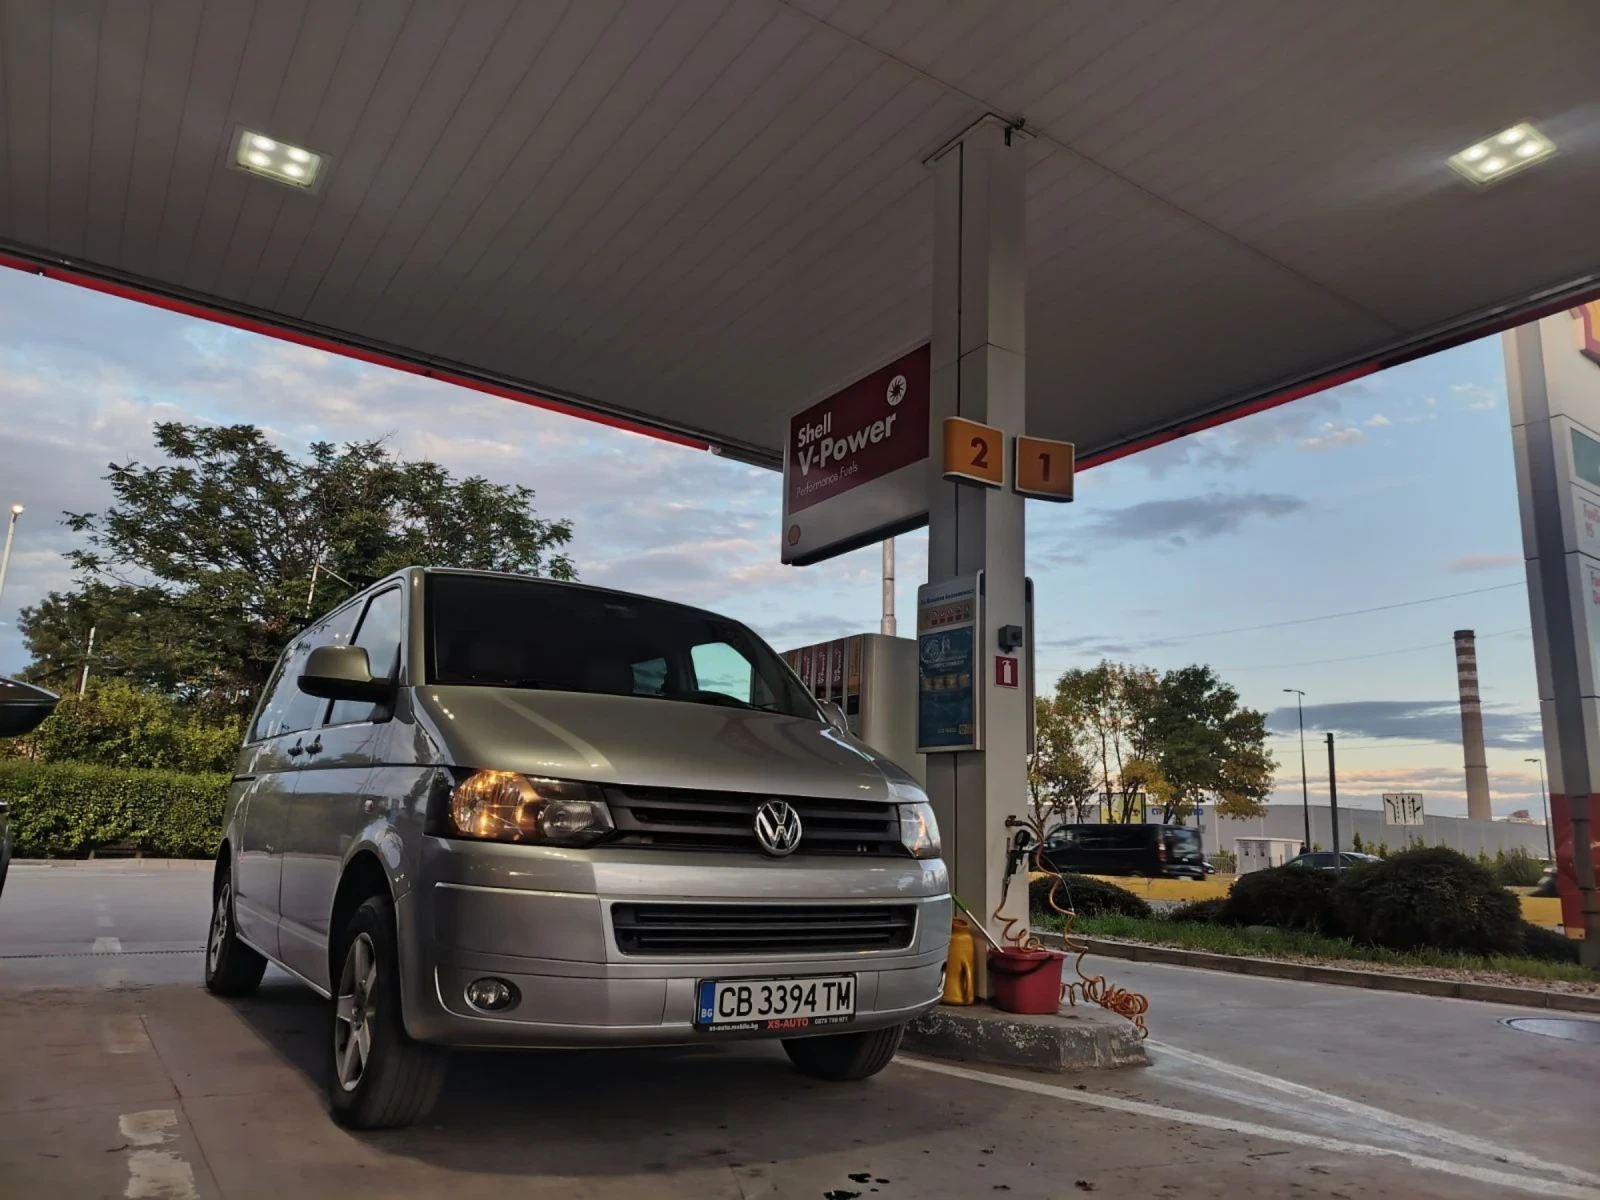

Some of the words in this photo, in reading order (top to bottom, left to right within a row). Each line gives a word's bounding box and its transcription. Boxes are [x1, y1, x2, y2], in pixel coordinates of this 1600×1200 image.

[798, 411, 832, 448] Shell
[798, 412, 897, 476] V-Power
[970, 436, 989, 469] 2
[1038, 452, 1052, 482] 1
[796, 473, 839, 499] Performance
[840, 460, 859, 479] Fuels
[701, 1008, 713, 1018] BG
[719, 986, 753, 1018] CB
[757, 983, 817, 1016] 3394
[822, 981, 852, 1012] TM
[767, 1017, 809, 1030] XS-AUTO
